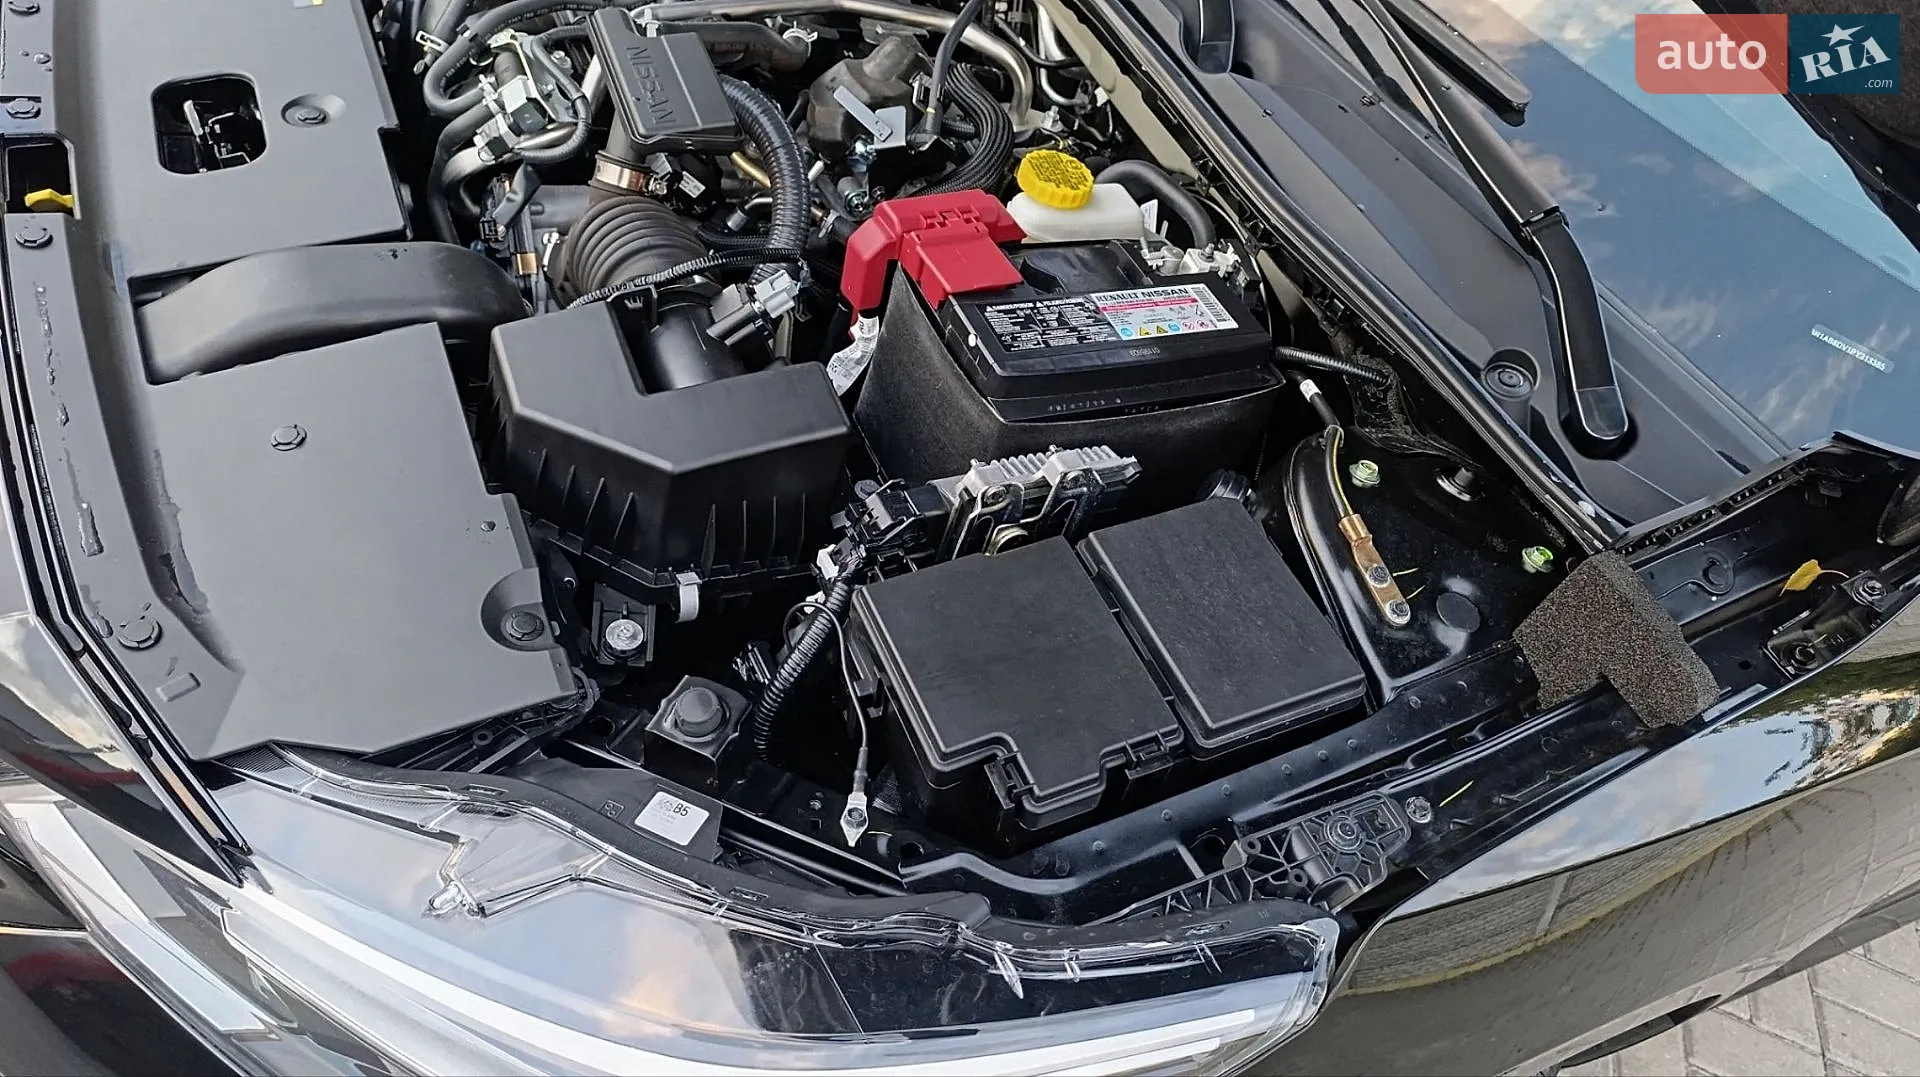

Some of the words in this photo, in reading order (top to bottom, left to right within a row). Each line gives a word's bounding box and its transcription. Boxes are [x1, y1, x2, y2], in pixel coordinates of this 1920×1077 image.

[626, 46, 678, 125] NISSAN
[1096, 292, 1139, 303] RENAULT
[1141, 287, 1189, 299] NISSAN
[673, 803, 691, 817] B5
